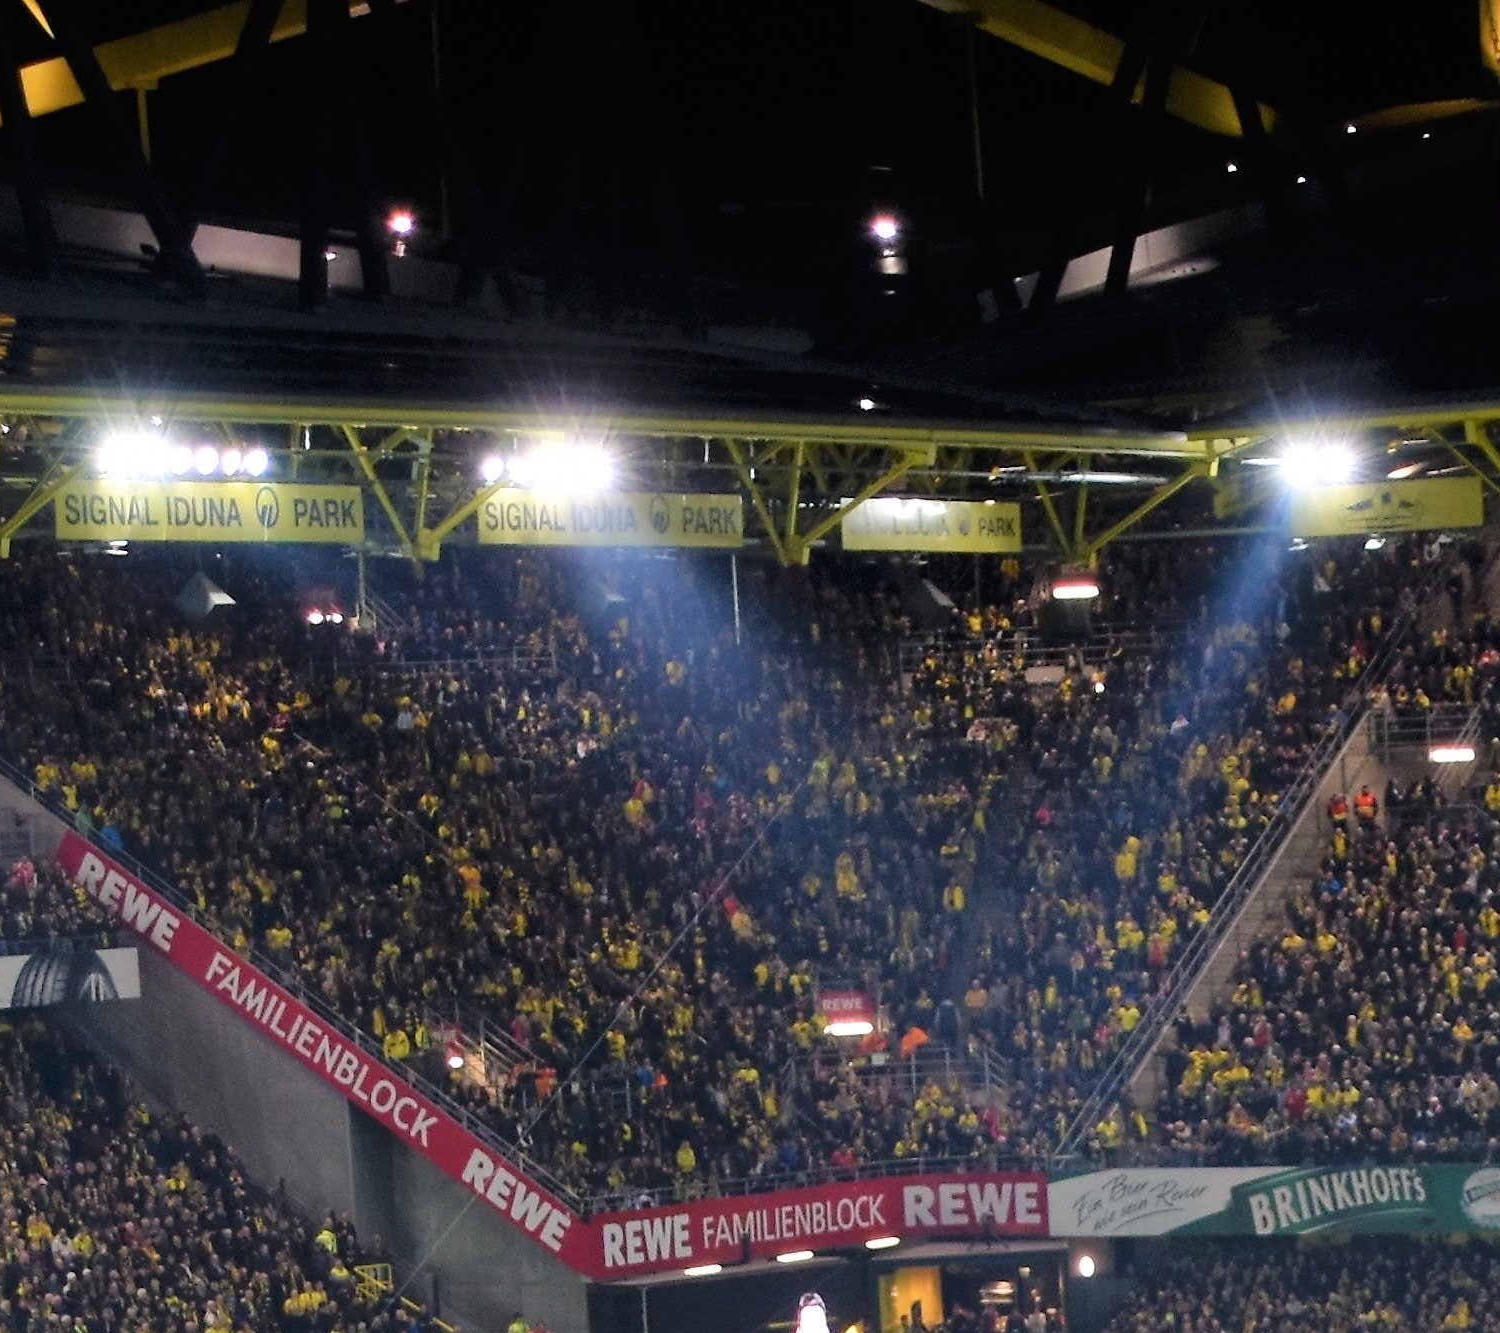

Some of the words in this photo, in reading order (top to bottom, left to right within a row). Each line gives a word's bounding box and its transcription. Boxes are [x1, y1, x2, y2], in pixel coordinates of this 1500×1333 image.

[65, 494, 158, 526] SIGNAL
[166, 497, 243, 527] IDUNA
[294, 497, 357, 528] PARK
[485, 501, 566, 532] SIGNAL
[572, 501, 638, 533] IDUNA
[683, 506, 737, 534] PARK
[978, 516, 1016, 538] PARK
[76, 852, 180, 952] REWE
[204, 952, 439, 1147] FAMILIENBLOCK
[461, 1147, 572, 1252] REWE
[603, 1213, 693, 1267] REWE
[703, 1193, 886, 1250] FAMILIENBLOCK
[903, 1181, 1046, 1227] REWE
